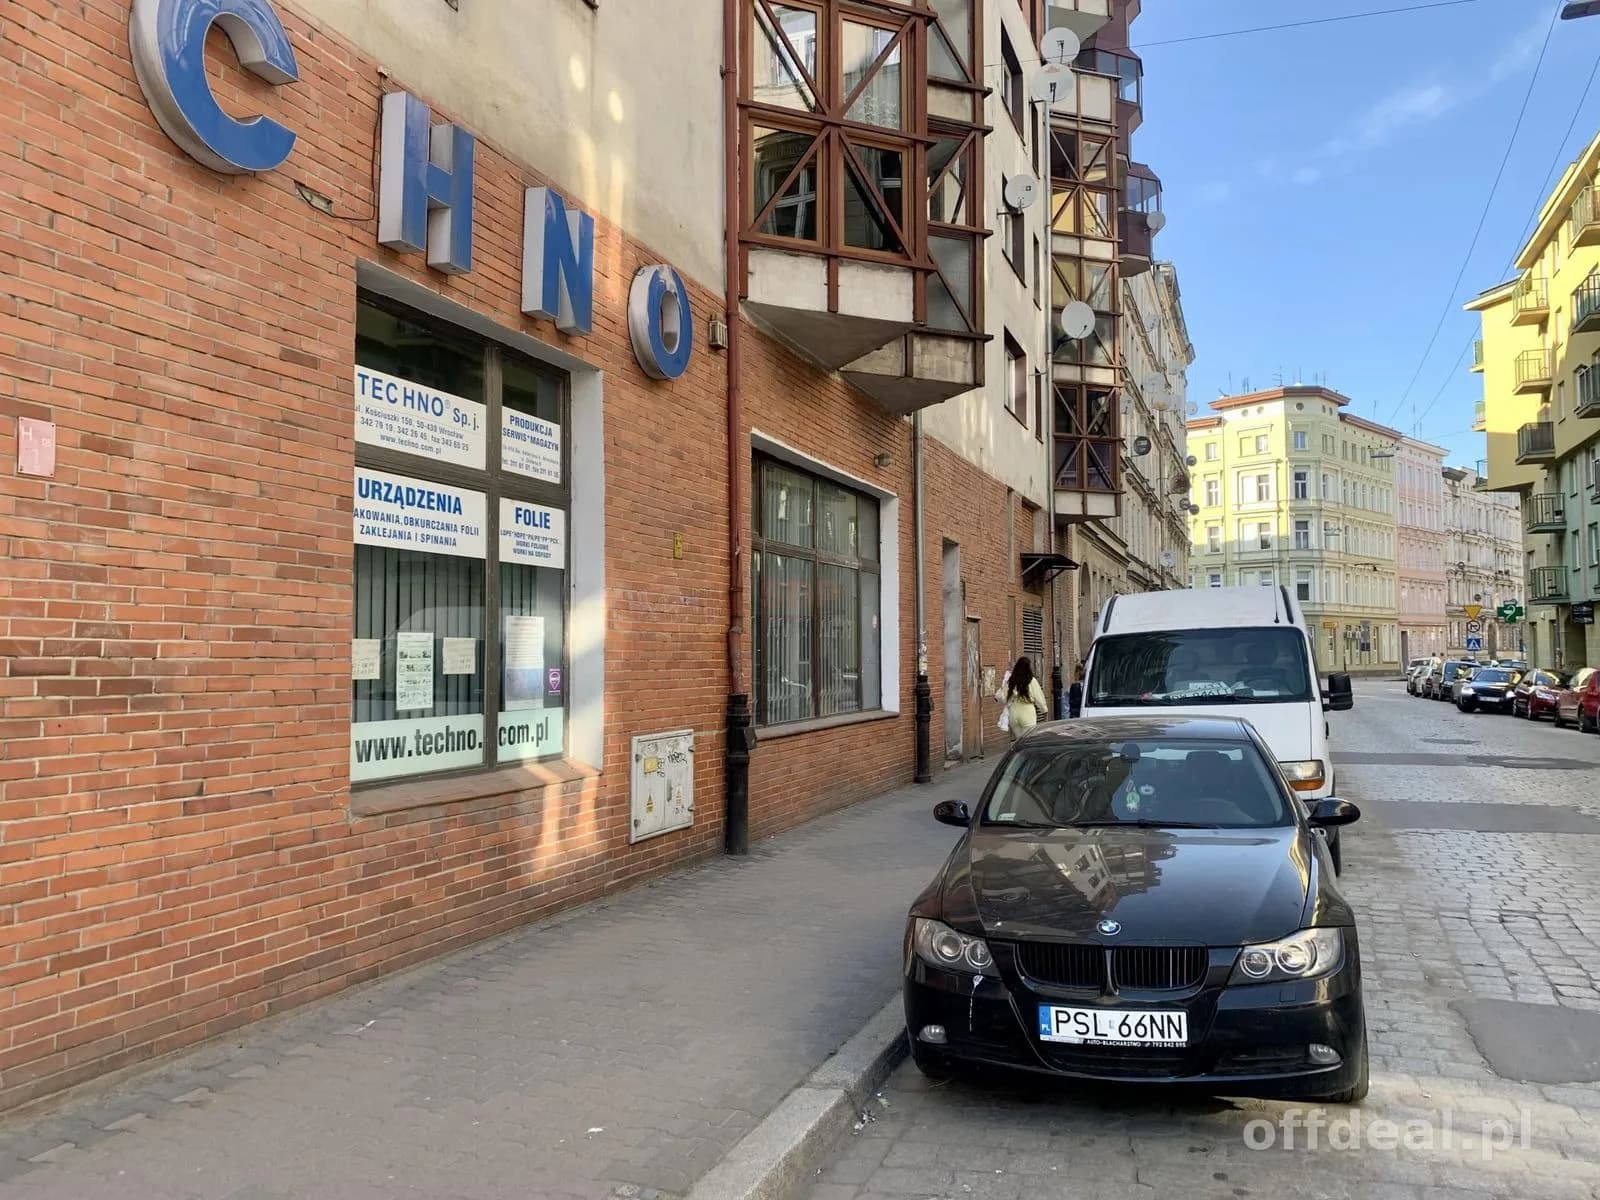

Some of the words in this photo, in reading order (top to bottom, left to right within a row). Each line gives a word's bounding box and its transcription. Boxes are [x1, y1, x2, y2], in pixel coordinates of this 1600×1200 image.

[509, 414, 553, 438] PRODUKCJA
[380, 434, 441, 455] www.techno.com.pl
[358, 477, 463, 516] URZĄDZENIA
[515, 506, 551, 530] FOLIE
[360, 524, 412, 542] ZAKLEJANIA
[420, 533, 457, 547] SPINANIA
[460, 525, 479, 537] FOLII
[498, 716, 549, 748] com.pl
[1055, 1009, 1108, 1038] PSL
[1118, 1013, 1183, 1040] 66NN
[1086, 1039, 1142, 1048] AUTO-BLACHARSTWO
